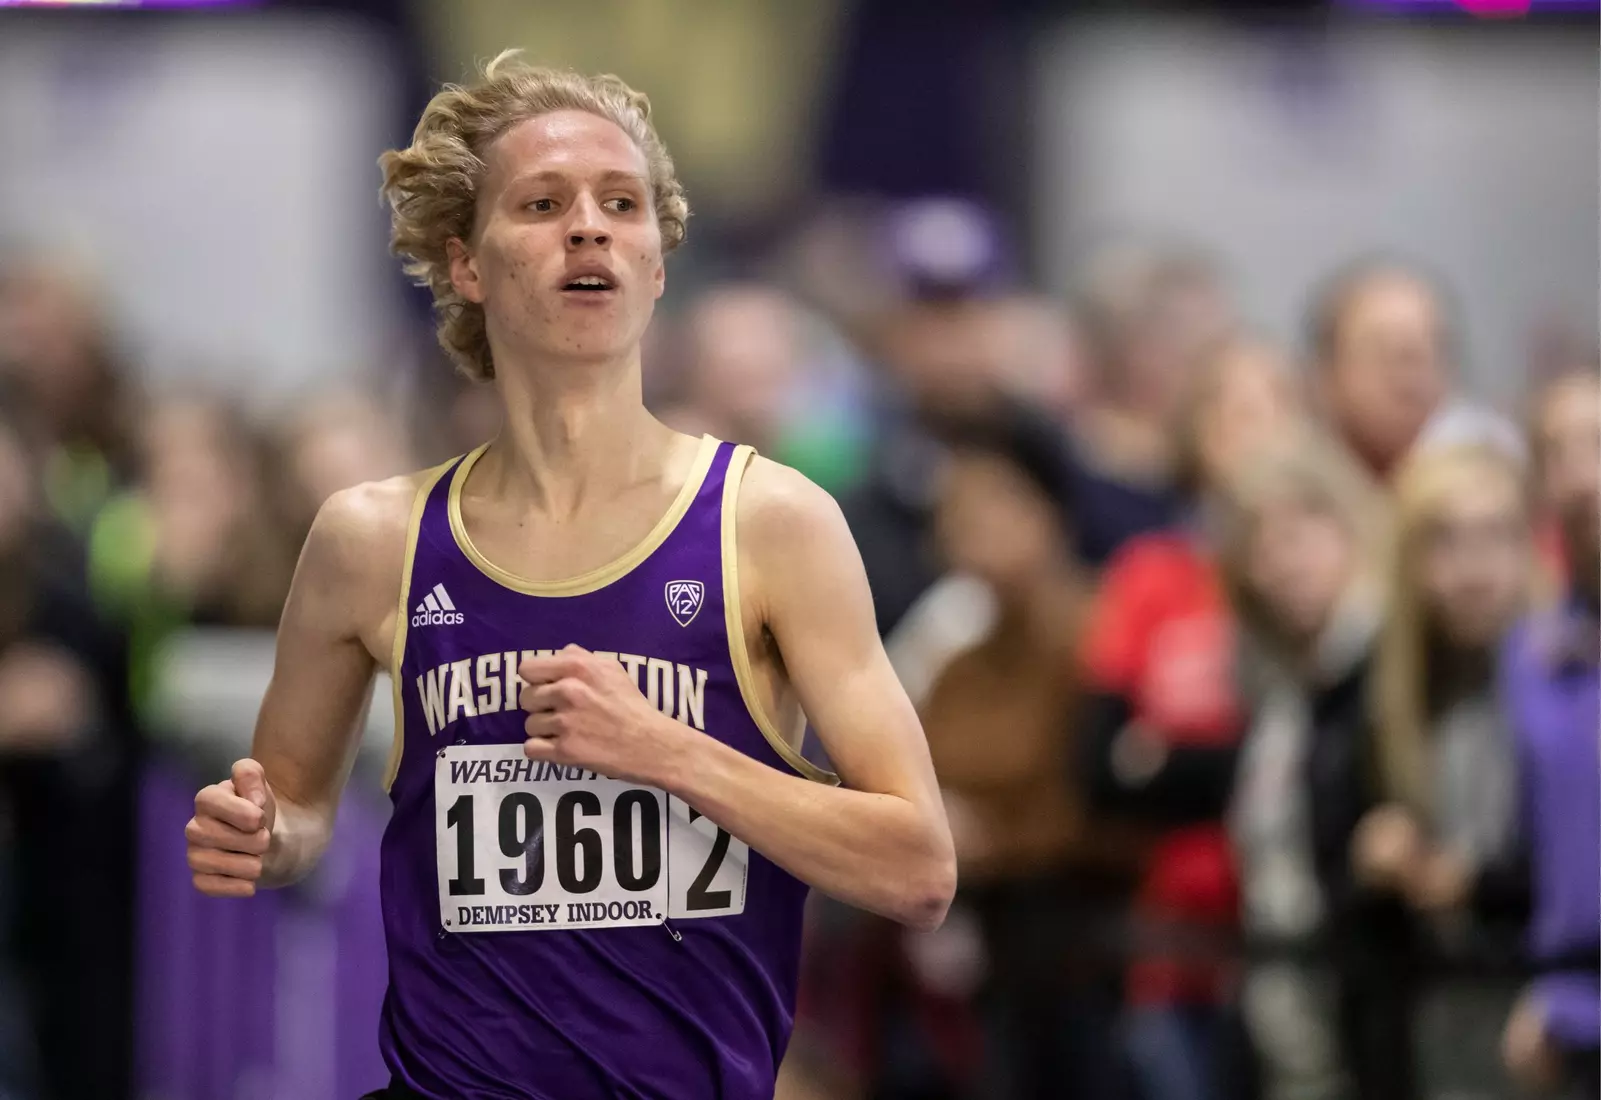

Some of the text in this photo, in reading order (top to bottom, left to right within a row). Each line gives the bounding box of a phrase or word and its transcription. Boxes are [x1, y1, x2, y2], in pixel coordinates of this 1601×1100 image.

[669, 583, 700, 607] PAC
[676, 599, 693, 615] 12
[411, 610, 465, 628] adidas
[416, 650, 708, 736] WASHTON
[447, 789, 661, 896] 1960
[686, 804, 732, 911] 2
[458, 900, 653, 926] DEMPSEY INDOOR
